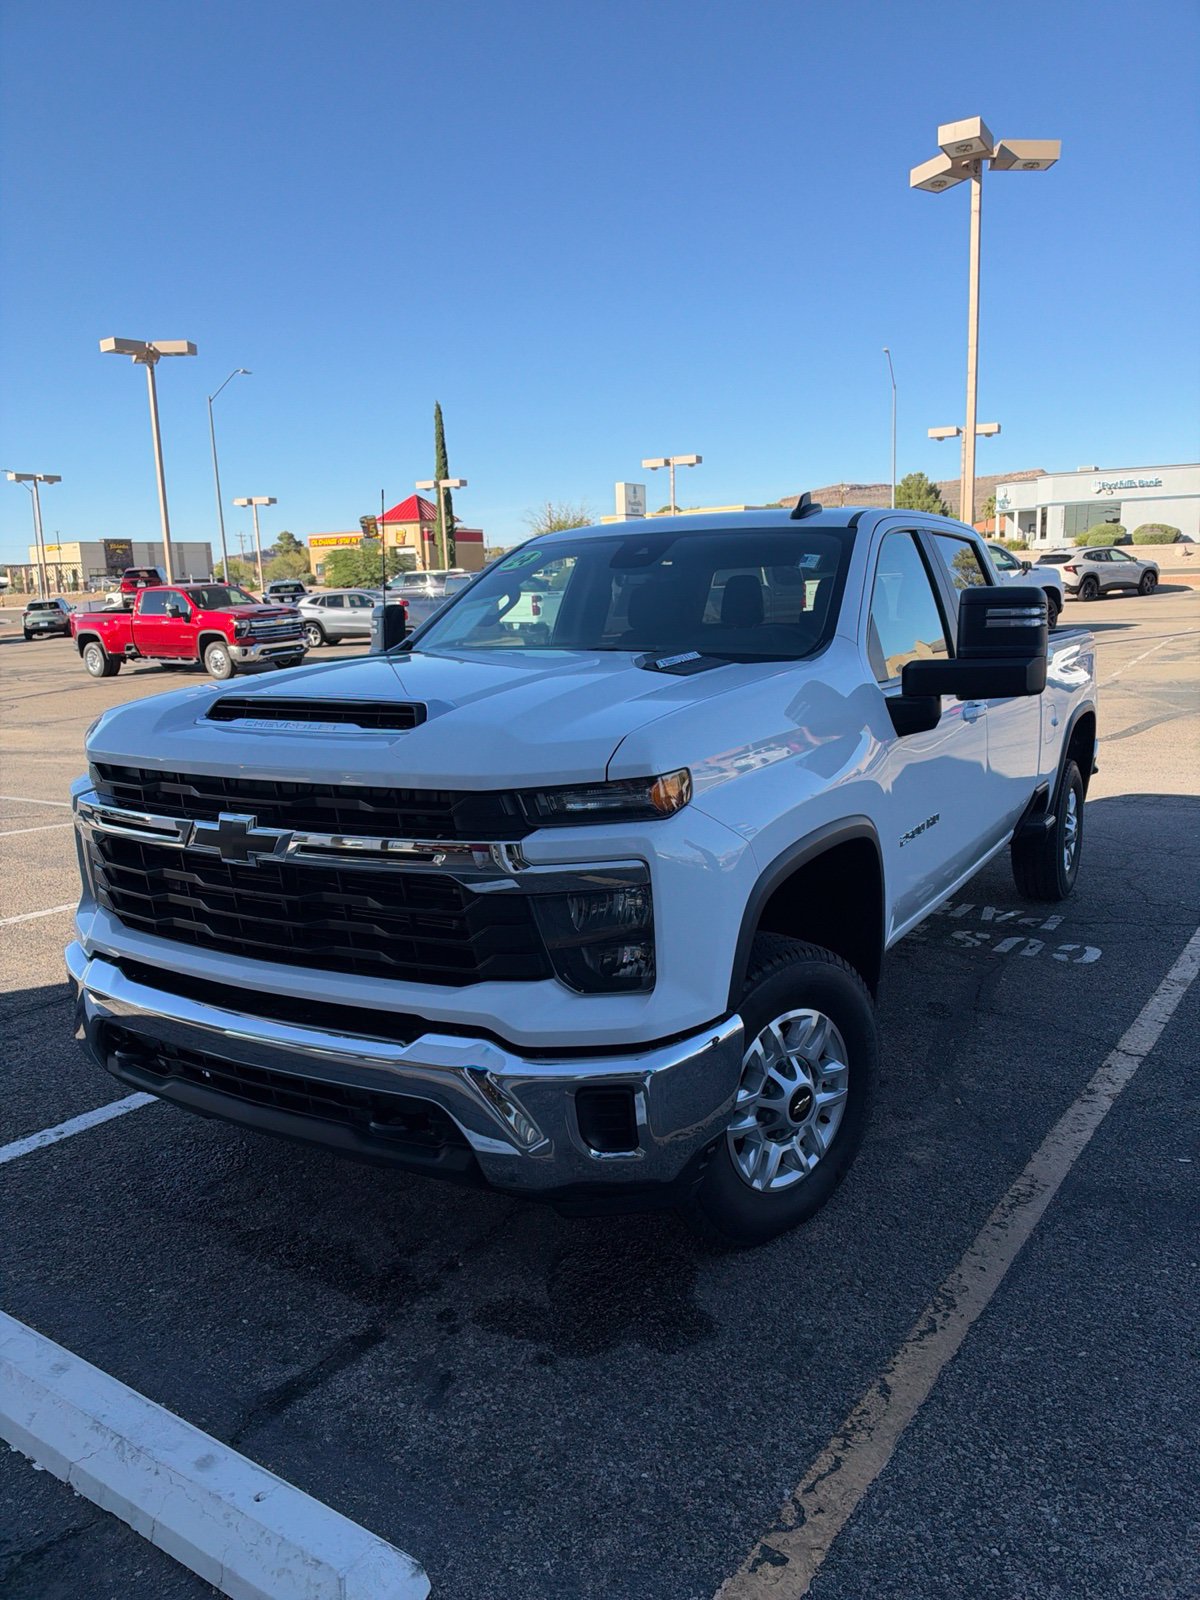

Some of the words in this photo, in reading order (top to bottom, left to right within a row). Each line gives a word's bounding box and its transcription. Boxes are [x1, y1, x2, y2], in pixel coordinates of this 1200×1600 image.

[1101, 479, 1138, 490] Foothills
[1138, 479, 1162, 488] Bank
[368, 523, 377, 536] 5
[244, 720, 337, 731] CHEVROLET
